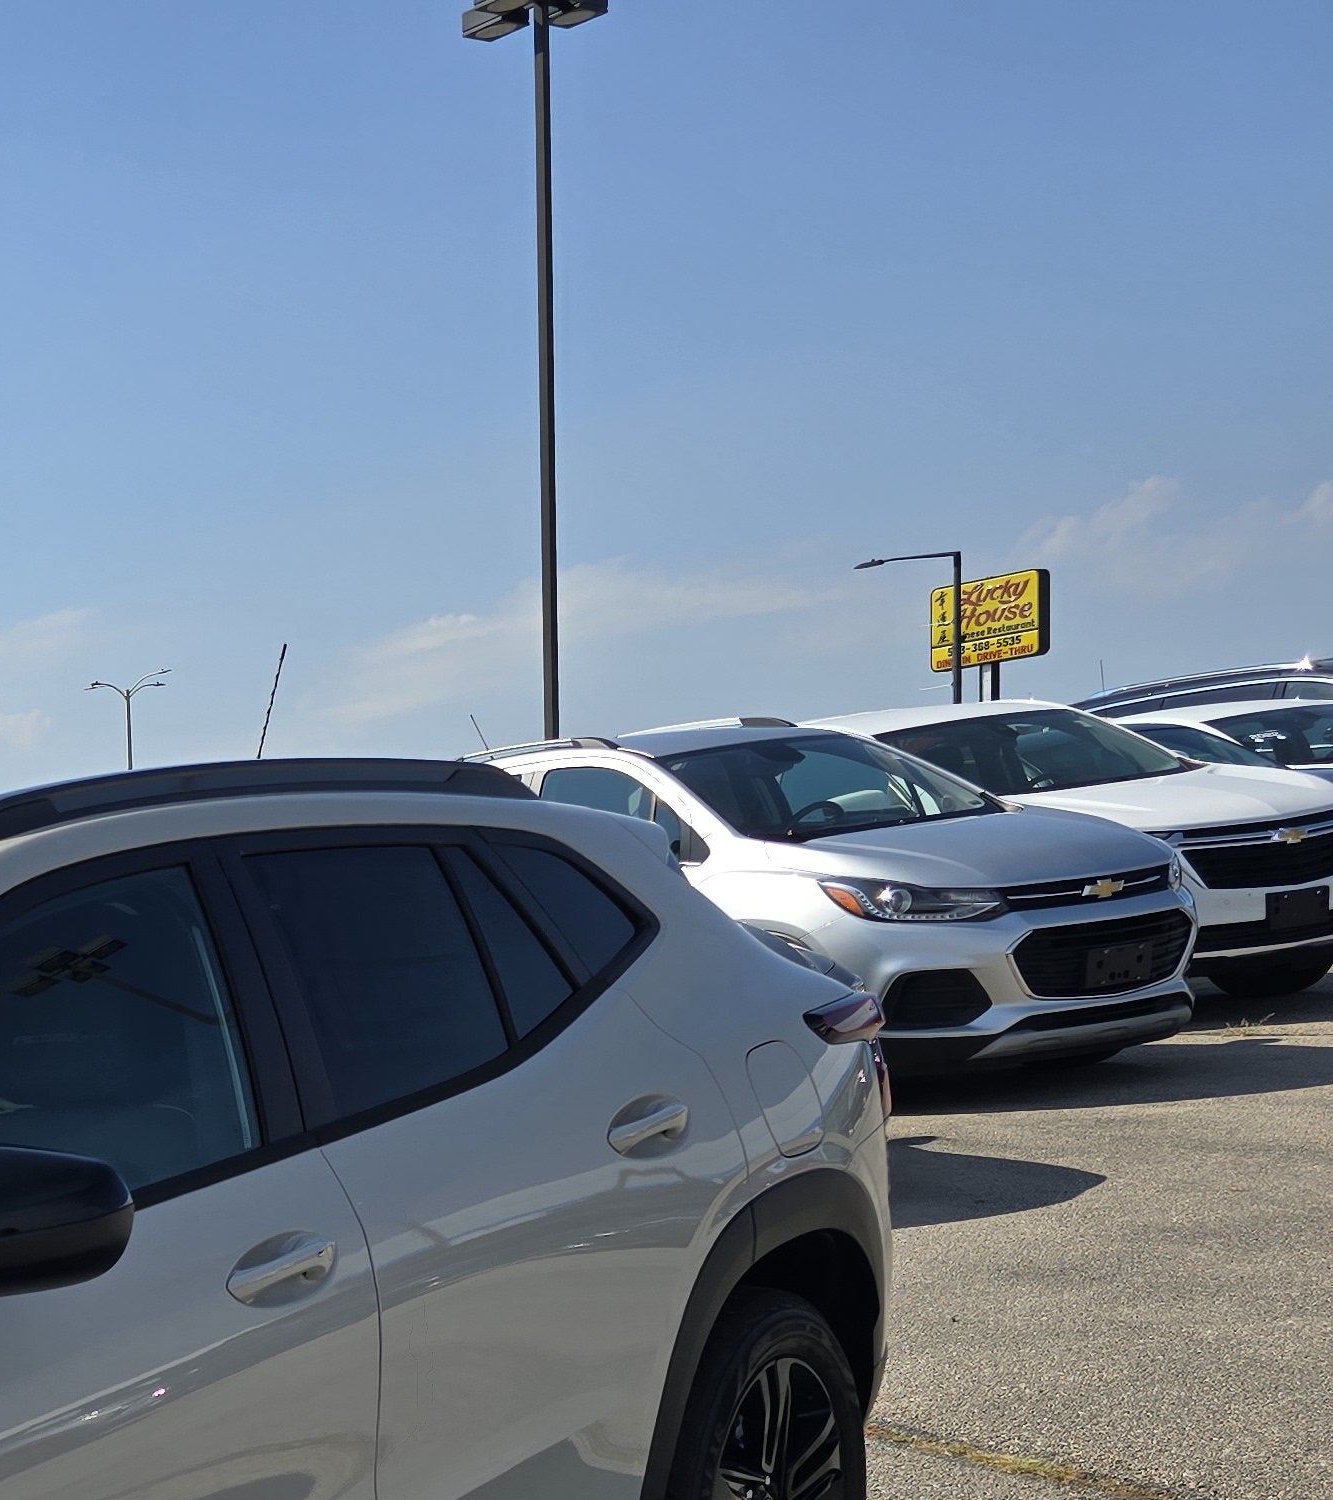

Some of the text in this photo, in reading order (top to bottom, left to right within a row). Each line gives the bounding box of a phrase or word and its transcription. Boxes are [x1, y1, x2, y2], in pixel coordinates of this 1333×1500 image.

[960, 578, 1031, 607] Lucky
[960, 601, 1033, 631] House
[986, 618, 1035, 635] Restaurant
[947, 635, 1022, 658] 53-368-5535
[976, 643, 1033, 662] DRIVE-THRU
